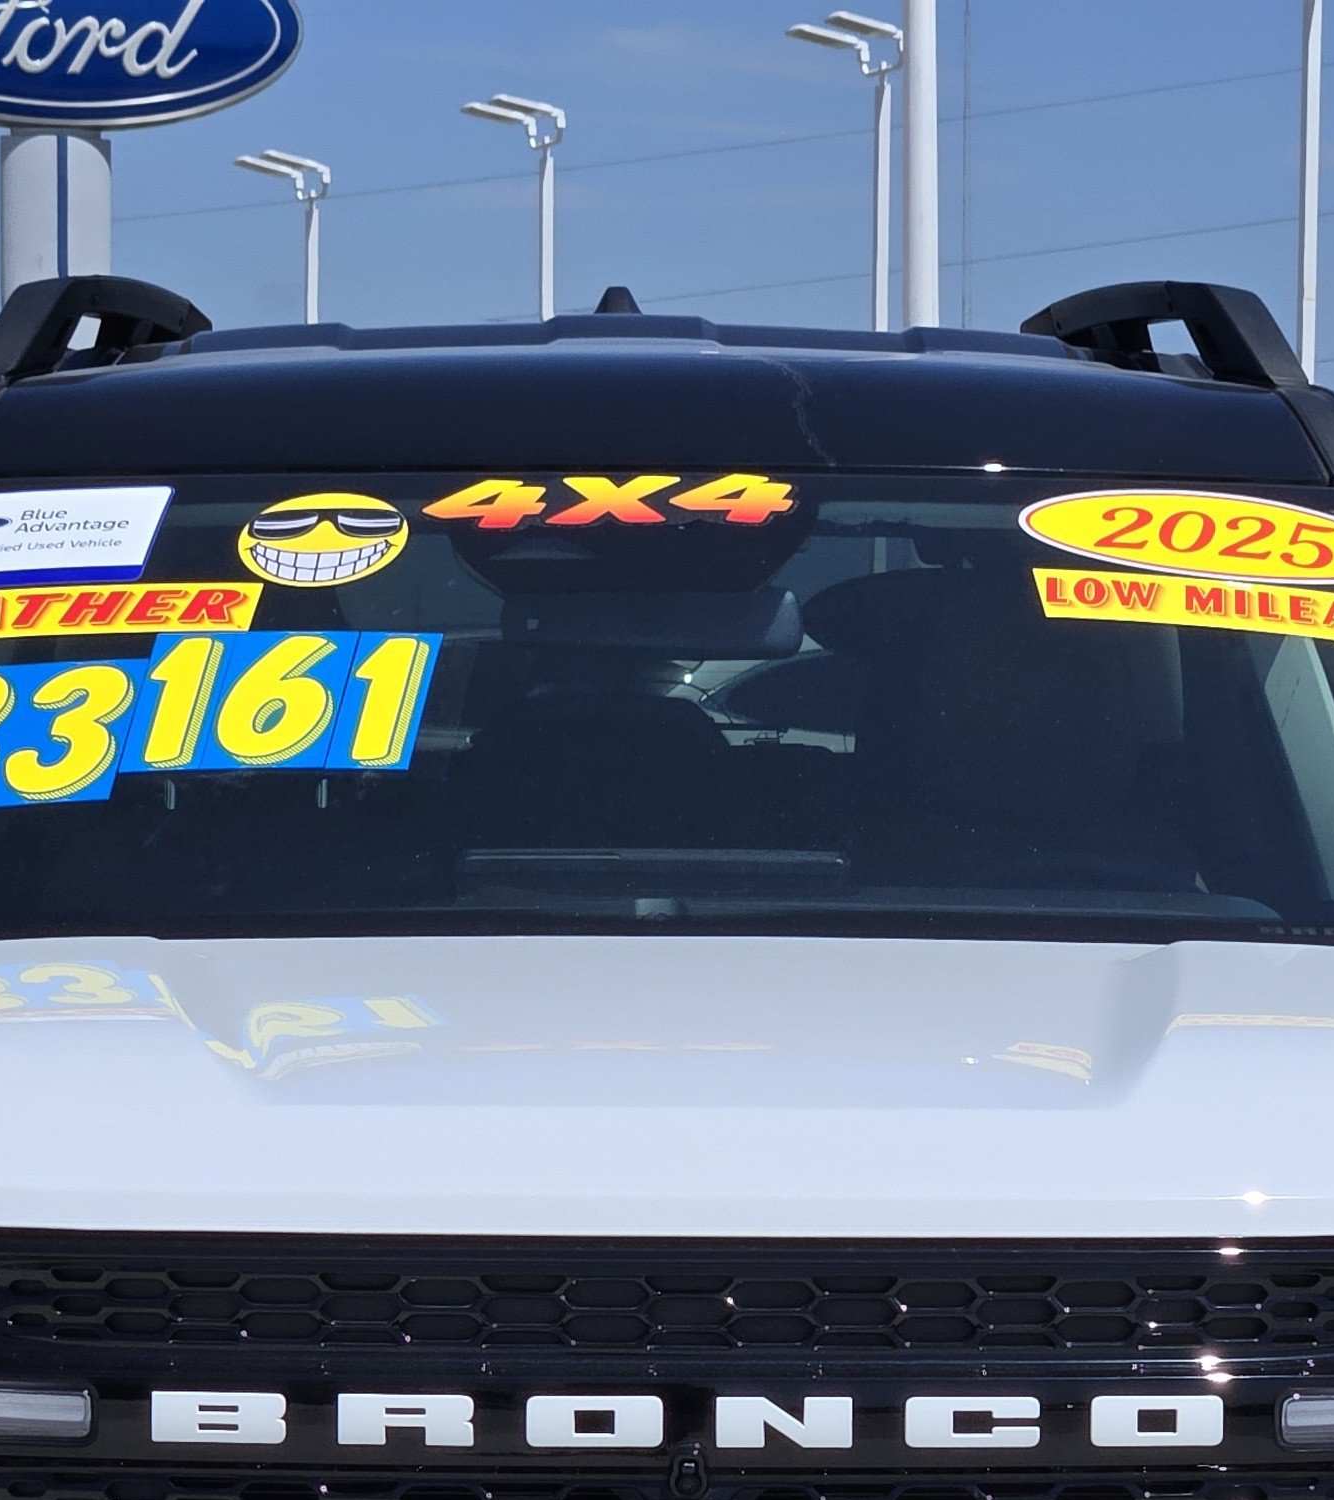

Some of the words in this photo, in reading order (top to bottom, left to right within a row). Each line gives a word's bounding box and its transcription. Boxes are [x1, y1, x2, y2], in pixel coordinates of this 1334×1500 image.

[422, 474, 793, 529] 4X4
[15, 519, 130, 533] Advantage
[20, 509, 68, 521] Blue
[27, 539, 65, 551] Used
[70, 537, 123, 549] Vehicle
[1045, 577, 1158, 609] LOW
[151, 1391, 1224, 1448] BRONCO
